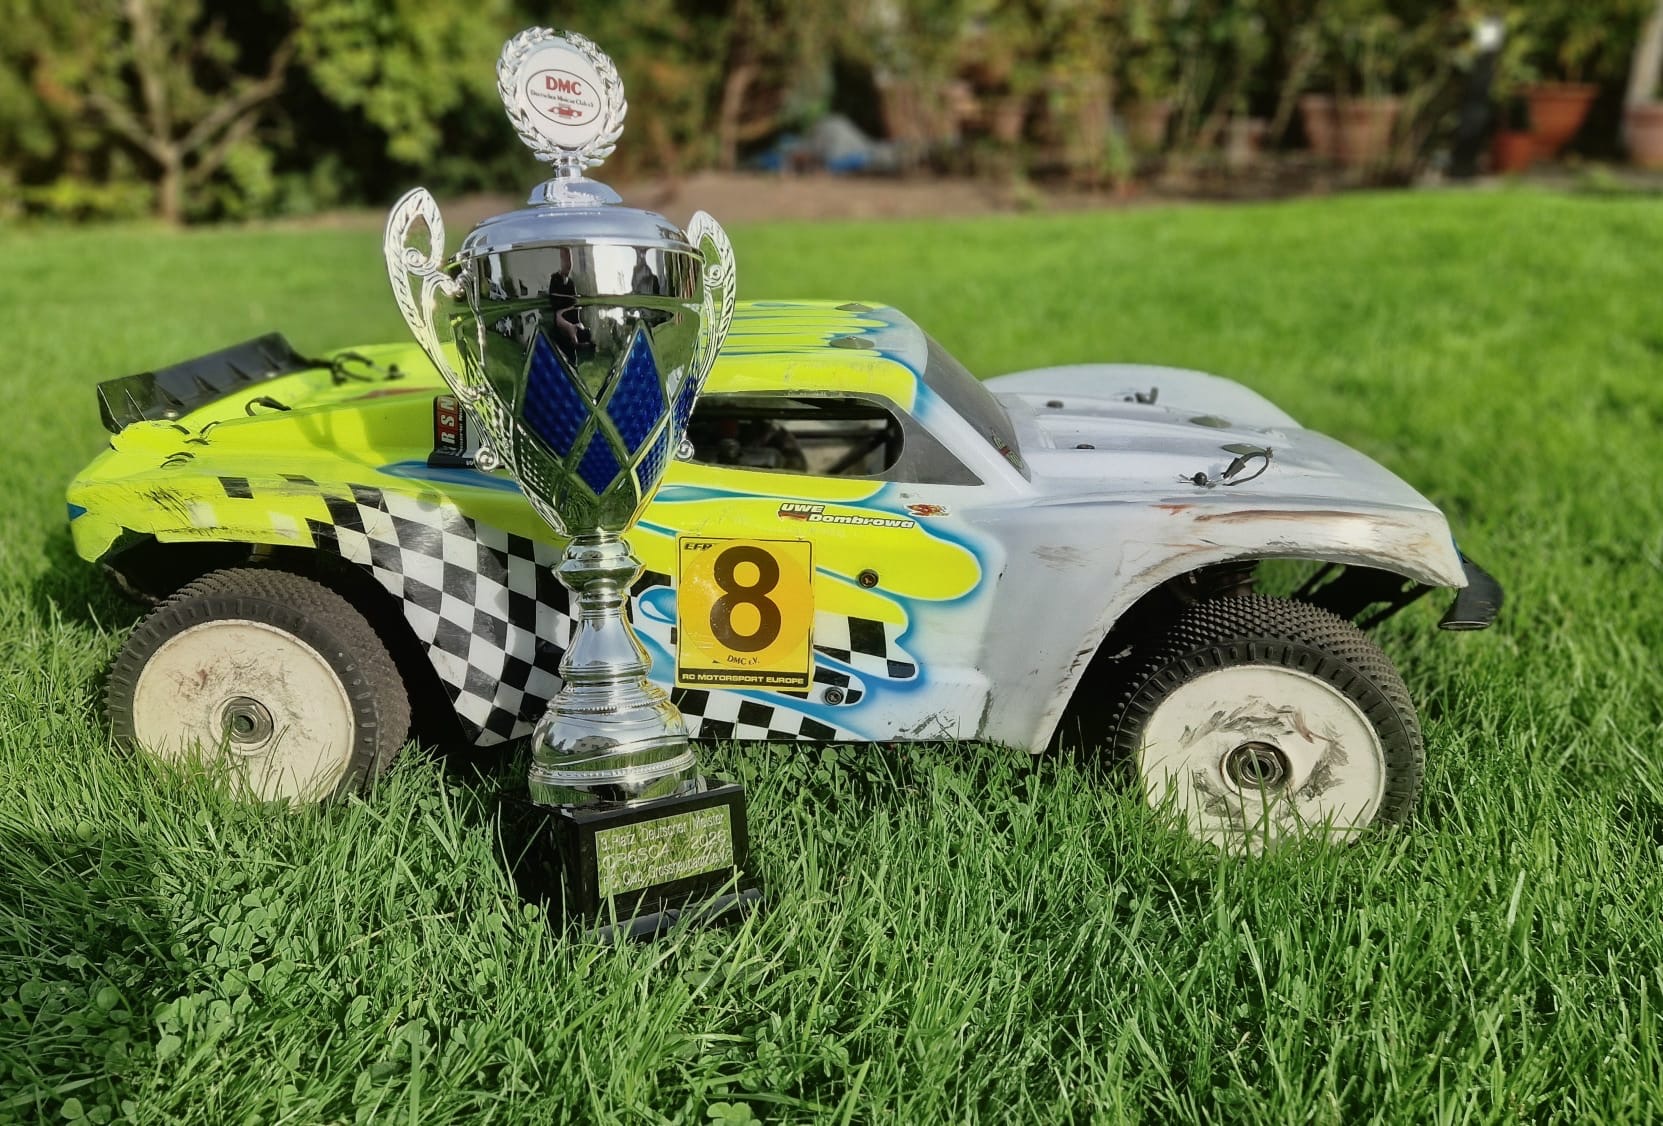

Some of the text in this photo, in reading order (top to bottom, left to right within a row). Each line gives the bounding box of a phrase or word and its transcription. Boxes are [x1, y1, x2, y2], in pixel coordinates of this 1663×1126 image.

[546, 75, 581, 95] DMC
[780, 503, 825, 514] UWE
[808, 513, 915, 528] Dombrowa
[709, 545, 782, 652] 8
[727, 655, 746, 665] DMC
[697, 674, 764, 683] MOTORSPORT
[765, 677, 805, 685] EUROPE
